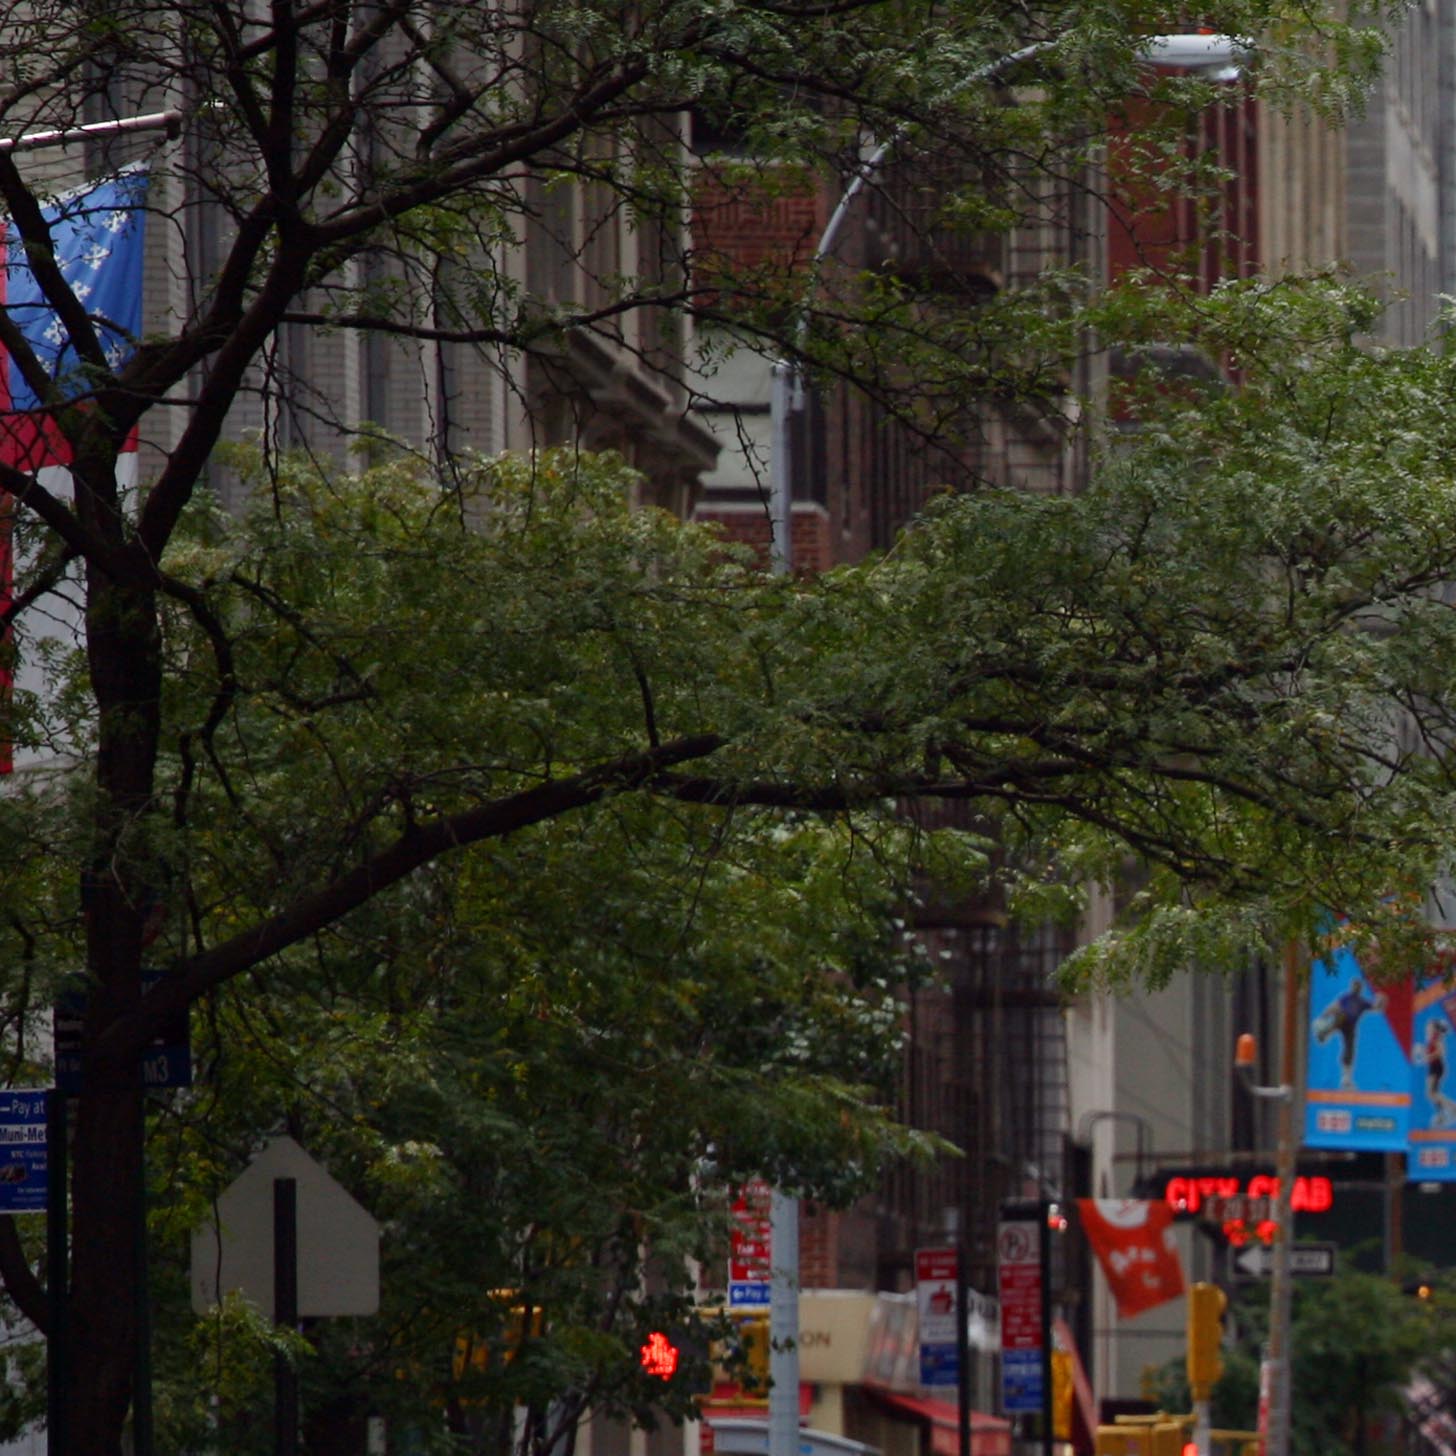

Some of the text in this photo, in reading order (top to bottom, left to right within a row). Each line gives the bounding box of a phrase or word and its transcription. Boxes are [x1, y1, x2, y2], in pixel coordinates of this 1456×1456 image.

[12, 1099, 45, 1118] Pay at
[1166, 1175, 1333, 1213] CITY CAB
